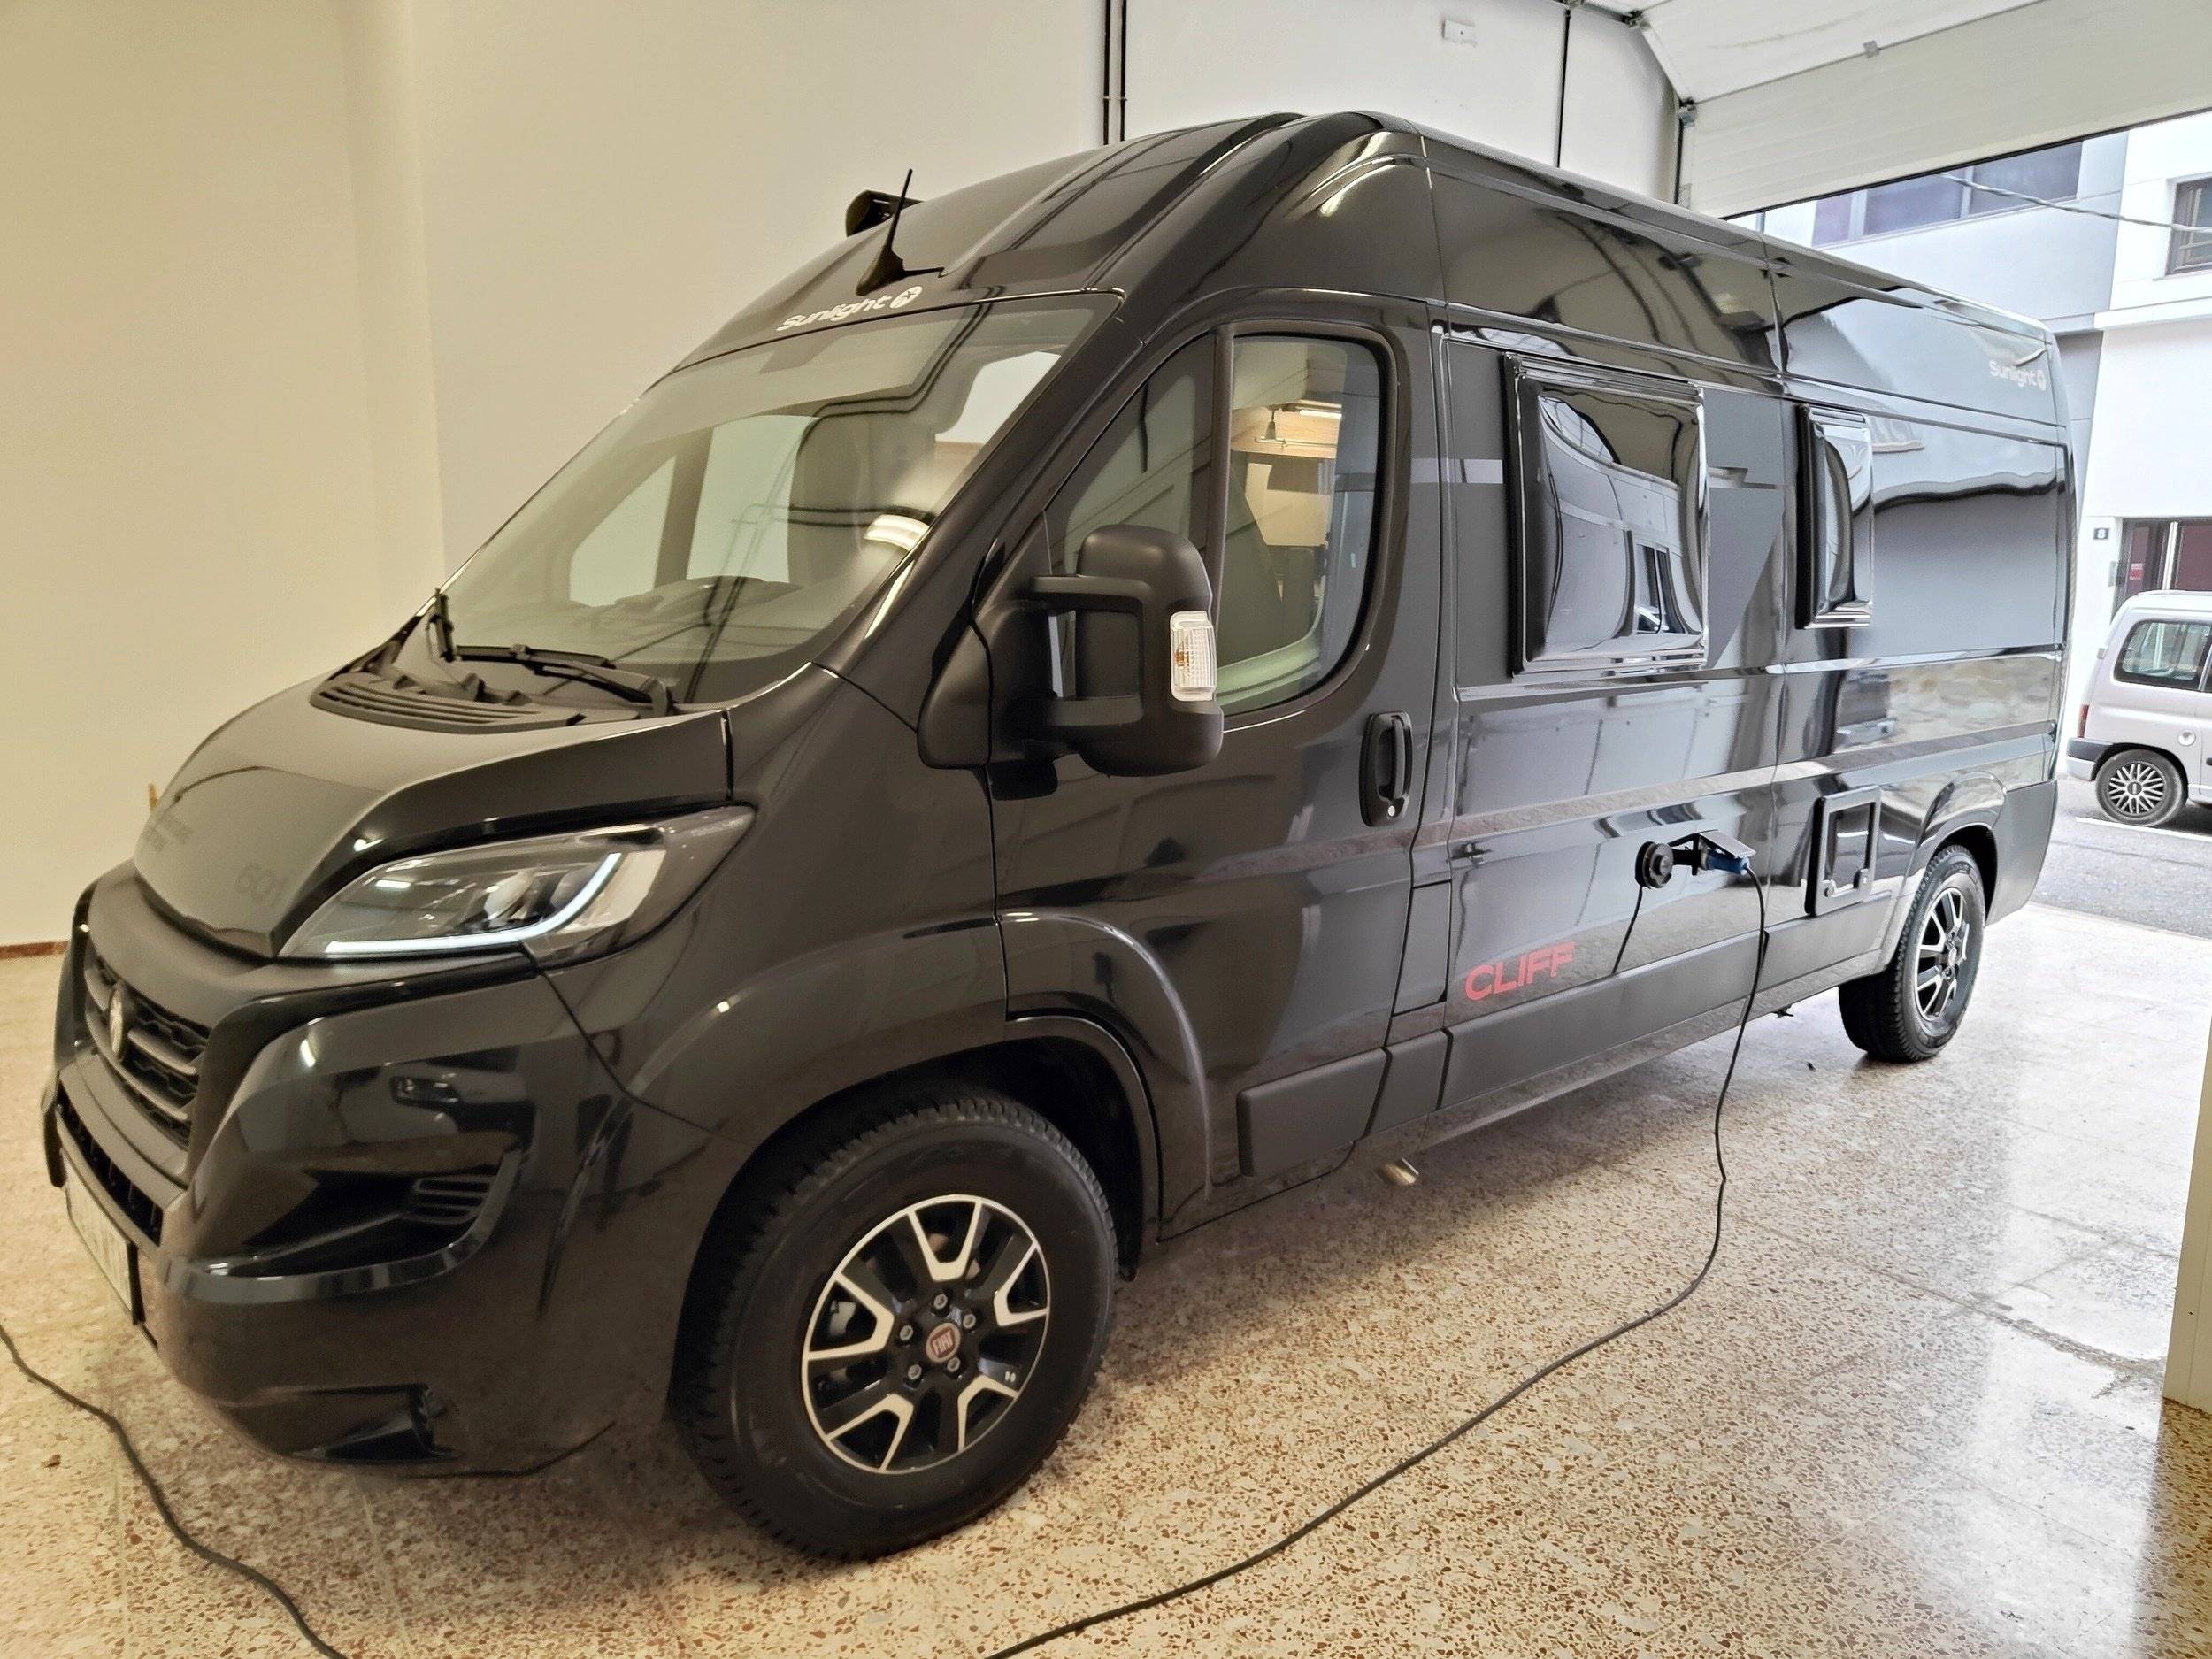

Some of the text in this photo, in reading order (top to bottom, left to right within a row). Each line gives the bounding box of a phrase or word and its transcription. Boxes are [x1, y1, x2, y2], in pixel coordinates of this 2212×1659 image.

[2097, 528, 2107, 540] 8
[1465, 941, 1577, 1001] CLIFF
[932, 1330, 954, 1355] FIAT
